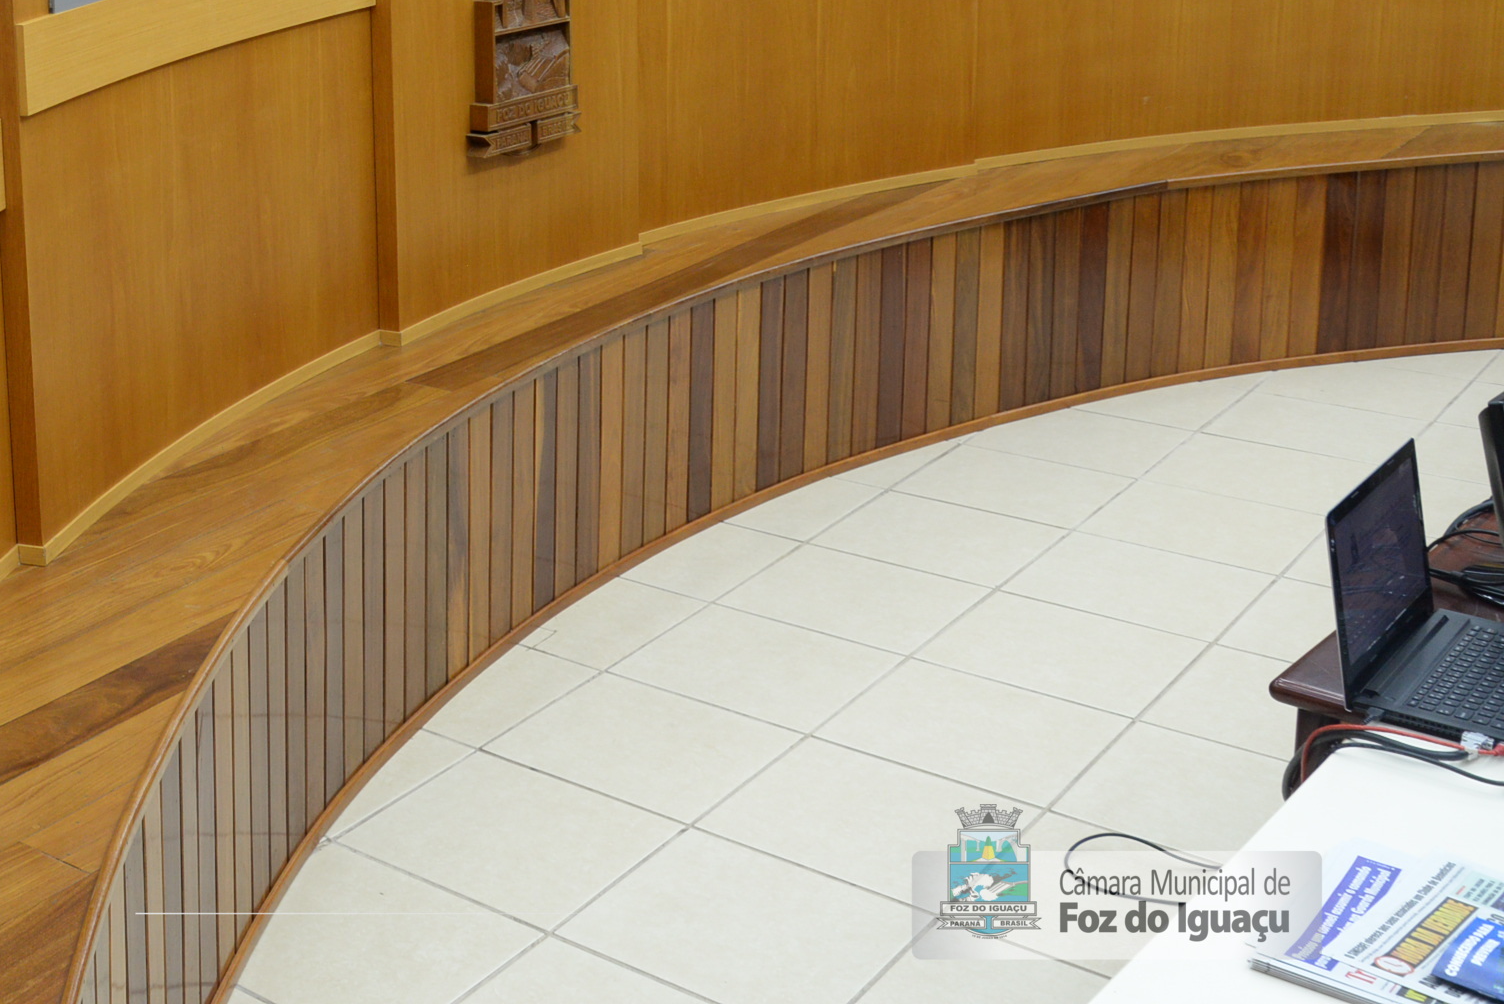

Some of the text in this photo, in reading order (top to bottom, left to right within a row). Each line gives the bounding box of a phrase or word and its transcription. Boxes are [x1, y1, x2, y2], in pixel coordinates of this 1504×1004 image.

[1331, 892, 1353, 916] assumir
[1348, 866, 1372, 891] comando
[1350, 895, 1375, 916] Guarda
[1363, 868, 1392, 896] Municipal
[1410, 927, 1445, 946] DA
